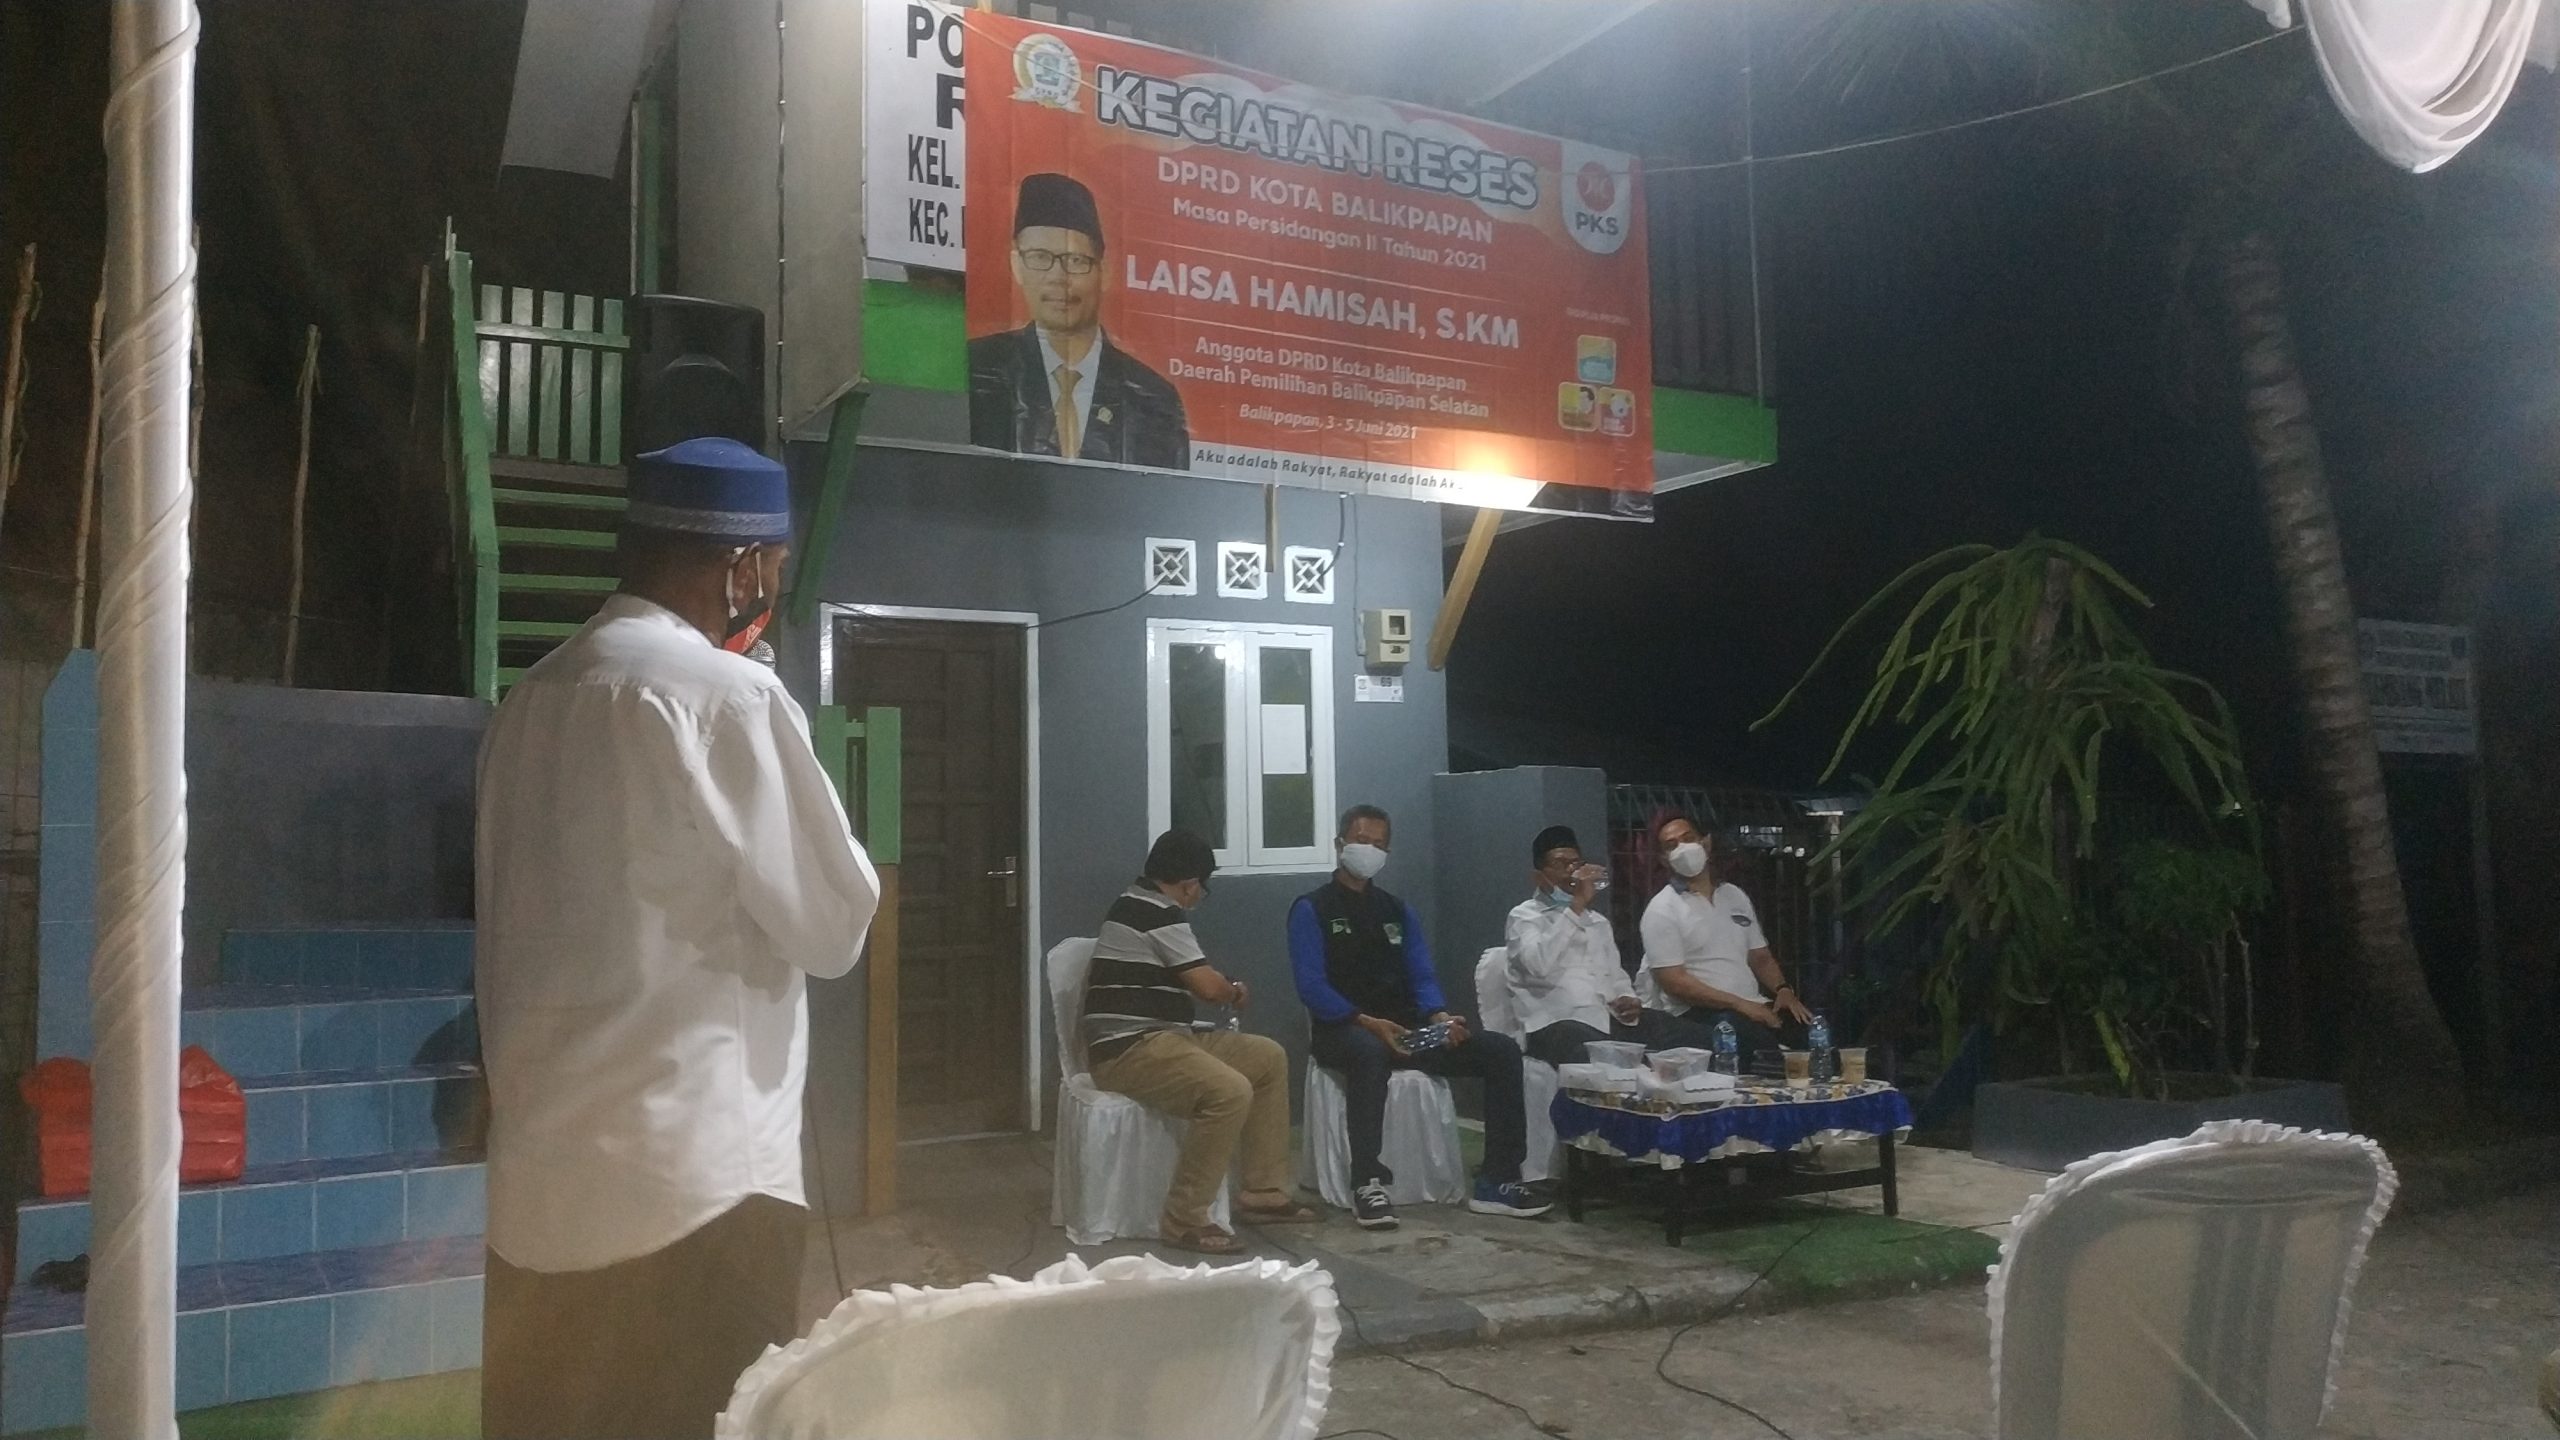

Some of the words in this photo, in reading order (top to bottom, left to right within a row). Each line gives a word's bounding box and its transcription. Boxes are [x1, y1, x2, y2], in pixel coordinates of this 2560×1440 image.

[908, 134, 960, 190] KEL.
[1097, 65, 1372, 176] KEGIATAN
[1382, 129, 1539, 209] RESES
[909, 198, 955, 248] KEC.
[1158, 156, 1240, 195] DPRD
[1250, 177, 1322, 213] KOTA
[1332, 194, 1492, 243] BALIKPAPAN
[1576, 211, 1618, 236] PKS
[1173, 198, 1229, 225] Masa
[1236, 209, 1360, 251] Persidangan
[1383, 238, 1438, 264] Tahun
[1444, 248, 1486, 270] 2021
[1126, 255, 1239, 305] LAISA
[1250, 276, 1425, 339] HAMISAH,
[1437, 313, 1519, 348] S.KM
[1169, 359, 1235, 384] Daerah
[1240, 368, 1327, 396] Pemilihan
[1332, 381, 1425, 409] Balikpapan
[1430, 393, 1489, 417] Selatan
[1195, 337, 1275, 369] Anggota
[1278, 349, 1327, 371] DPRD
[1333, 356, 1370, 377] Kota
[1376, 363, 1466, 390] Balikpapan
[1240, 404, 1324, 430] Balikpapan,
[1327, 417, 1335, 430] 3
[1345, 419, 1353, 432] 5
[1354, 418, 1384, 437] Juni
[1384, 423, 1417, 440] 2021
[1195, 450, 1224, 466] Aku
[1227, 451, 1279, 471] adalah
[1282, 457, 1336, 479] Rakyat,
[1340, 465, 1386, 483] Rakyat
[1390, 470, 1437, 489] adalah
